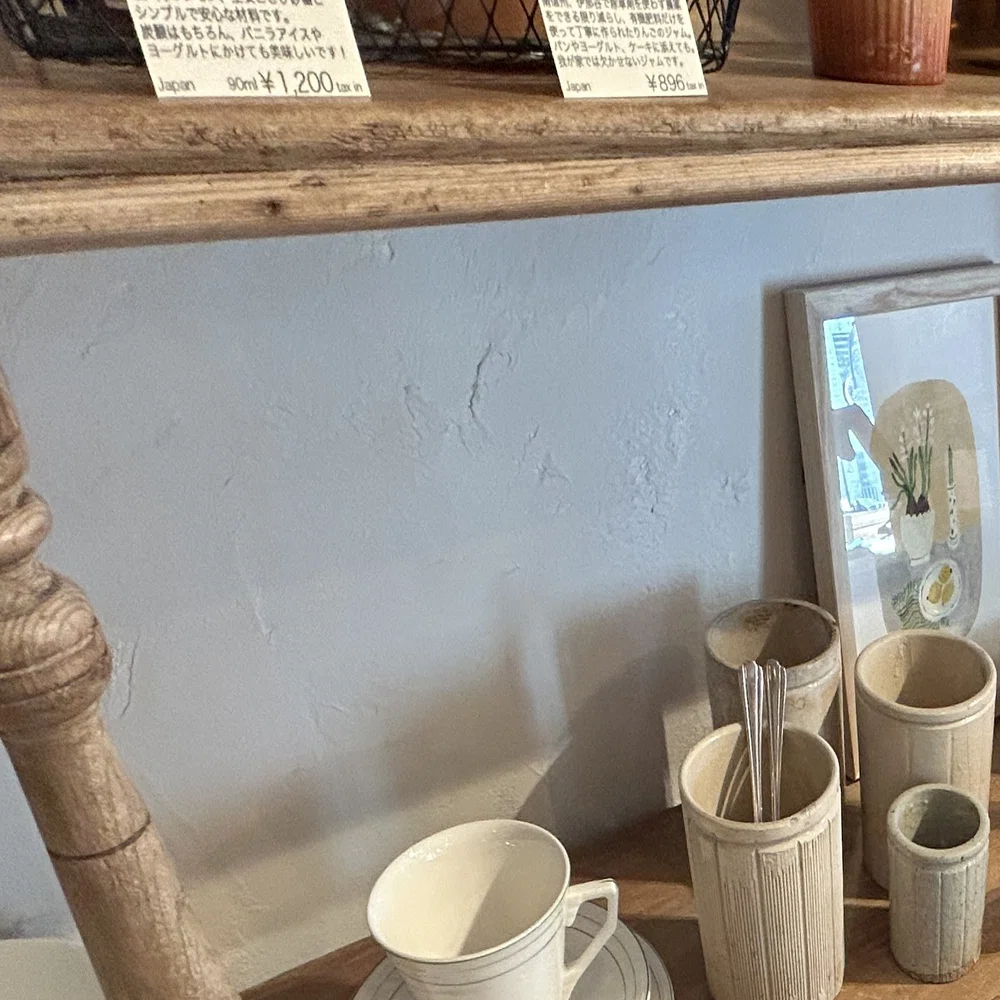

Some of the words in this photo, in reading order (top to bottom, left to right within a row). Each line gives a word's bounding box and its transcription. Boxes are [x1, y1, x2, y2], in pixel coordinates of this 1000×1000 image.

[136, 6, 291, 25] シンプルで安心な材料です。
[158, 77, 196, 95] Japan
[227, 76, 258, 92] 90ml
[258, 70, 334, 96] ¥1,200
[337, 81, 352, 93] tax
[353, 81, 363, 92] in
[565, 80, 592, 94] Japan
[645, 73, 686, 93] ¥896
[686, 82, 698, 91] tax
